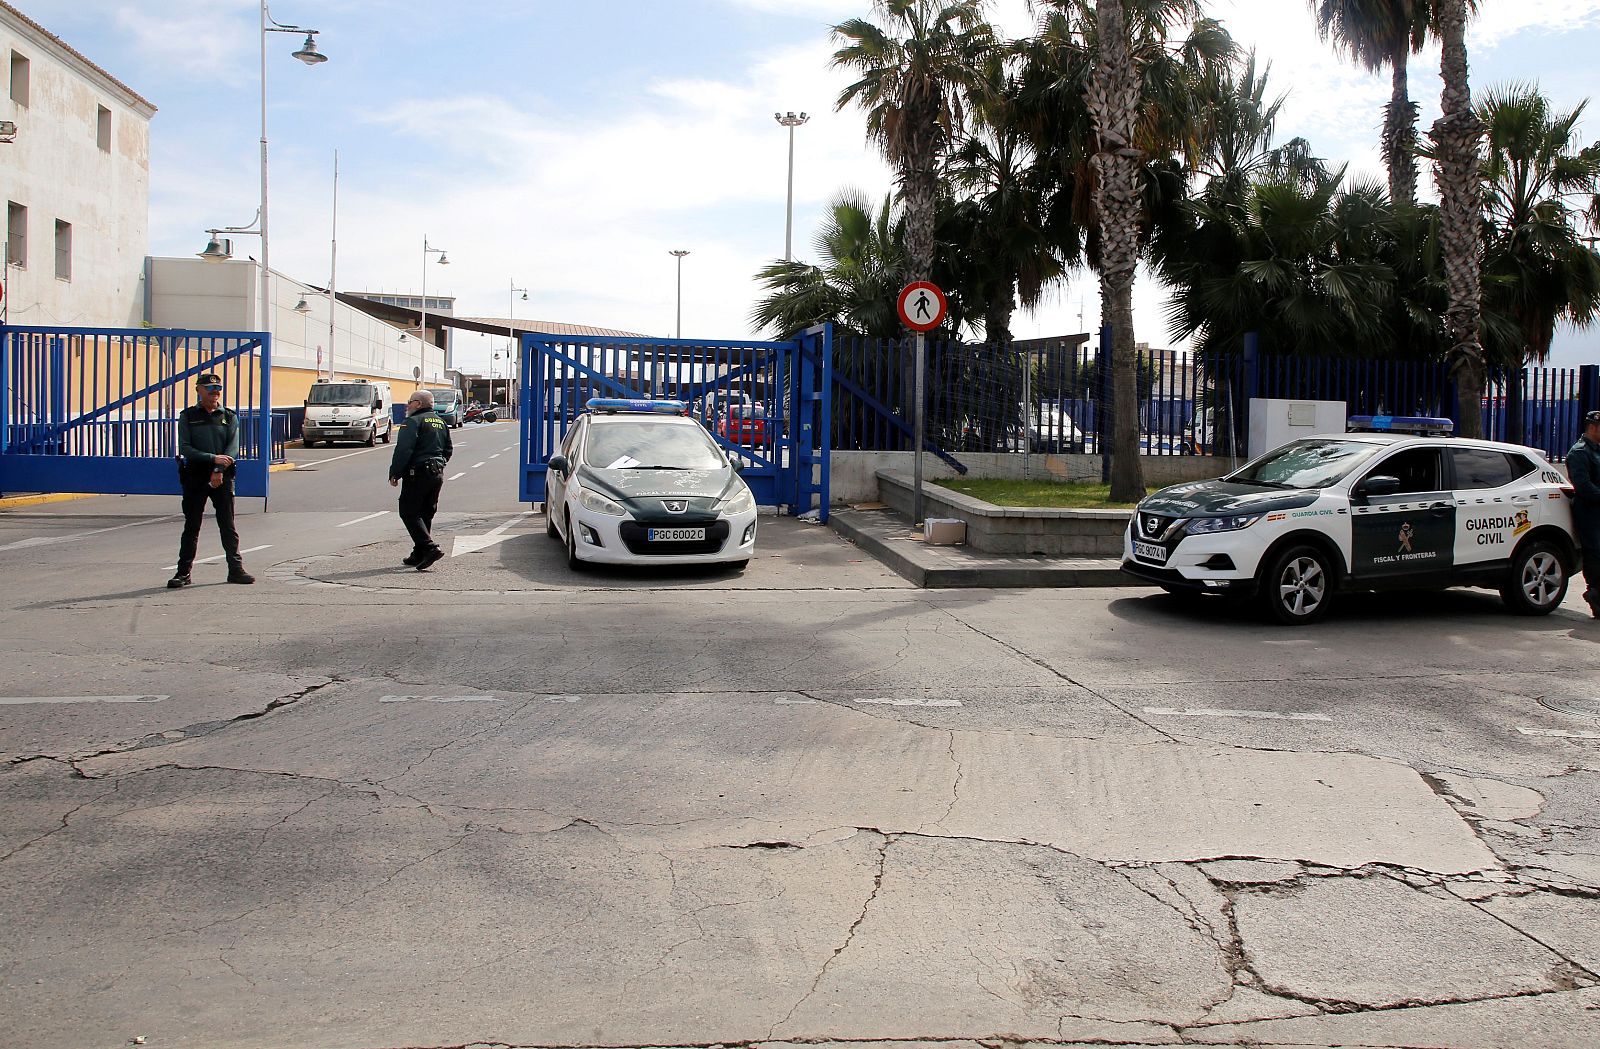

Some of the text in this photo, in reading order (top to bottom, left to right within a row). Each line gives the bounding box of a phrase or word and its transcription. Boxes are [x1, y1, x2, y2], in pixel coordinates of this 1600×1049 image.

[1291, 510, 1318, 518] GUARDIA
[1466, 516, 1515, 531] GUARDIA
[653, 530, 703, 540] PGC 6002 C
[1477, 532, 1504, 545] CIVIL
[1145, 545, 1160, 558] 9074
[1160, 548, 1166, 559] N
[1373, 555, 1395, 564] FISCAL
[1401, 551, 1437, 560] FRONTERAS
